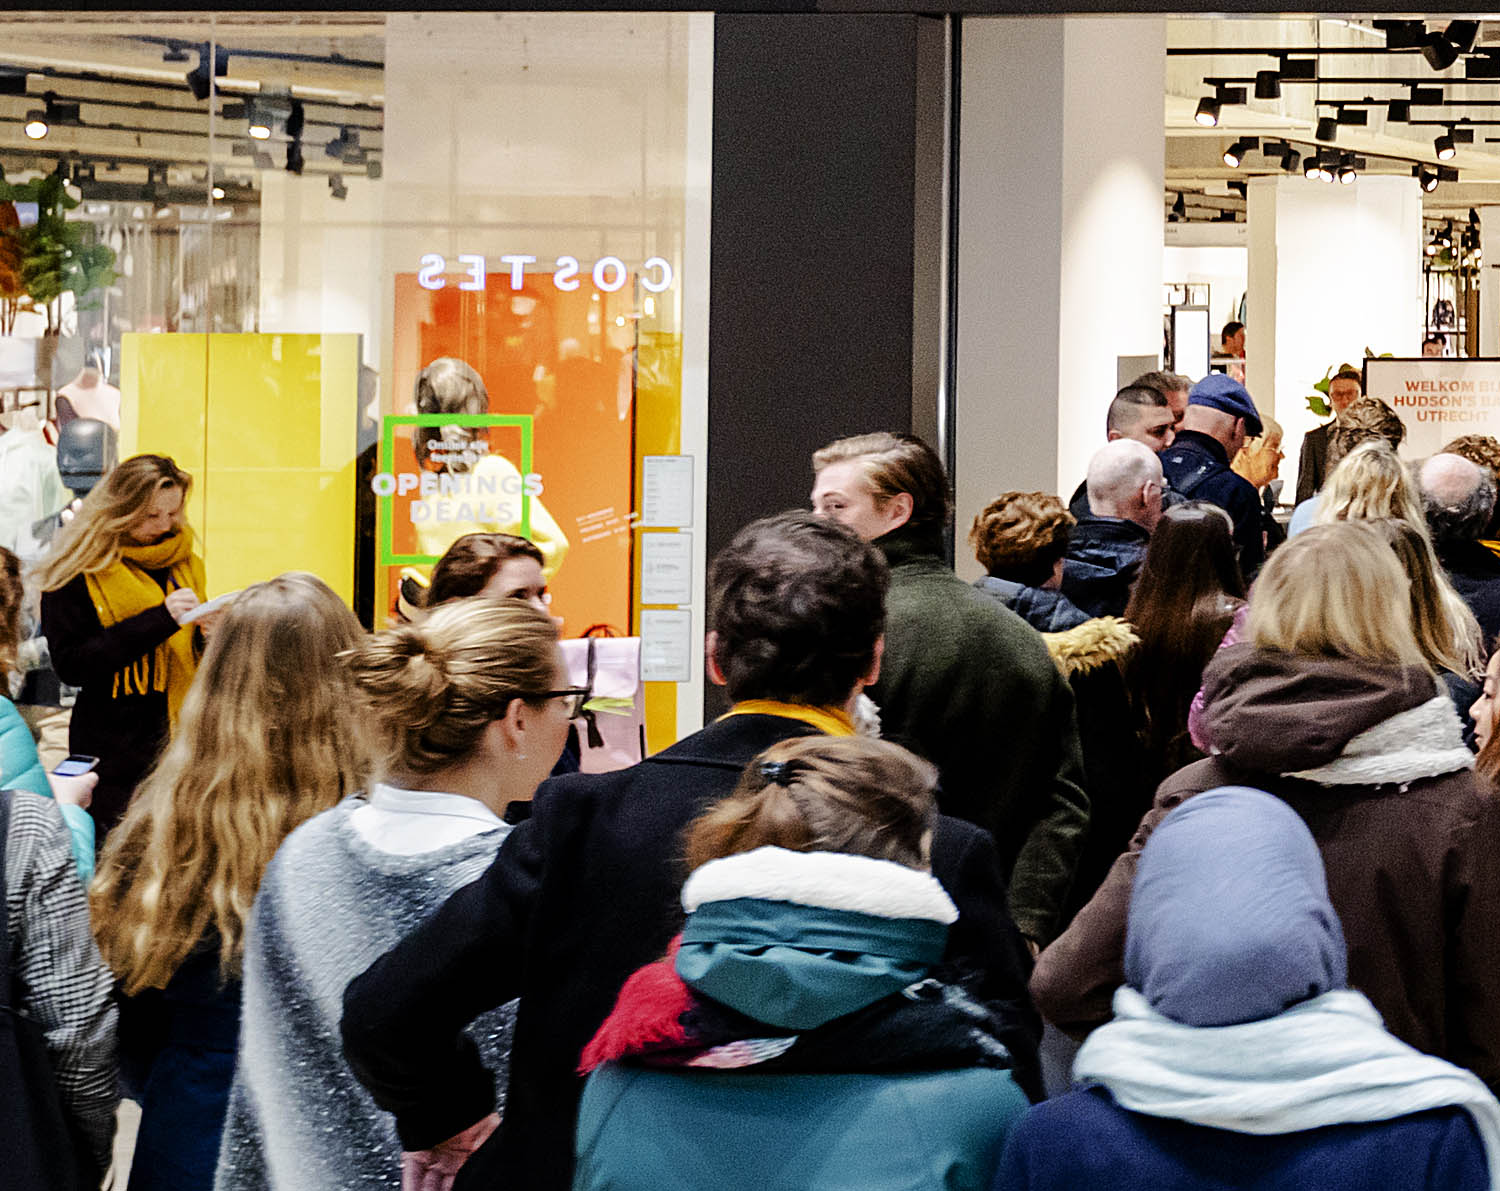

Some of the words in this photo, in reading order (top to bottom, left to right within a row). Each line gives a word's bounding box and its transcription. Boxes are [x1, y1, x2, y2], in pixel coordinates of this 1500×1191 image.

[1405, 380, 1475, 392] WELKOM
[1394, 395, 1477, 407] HUDSON'S
[1417, 410, 1488, 422] UTRECHT
[371, 472, 544, 497] OPENINGS
[410, 500, 513, 524] DEALS
